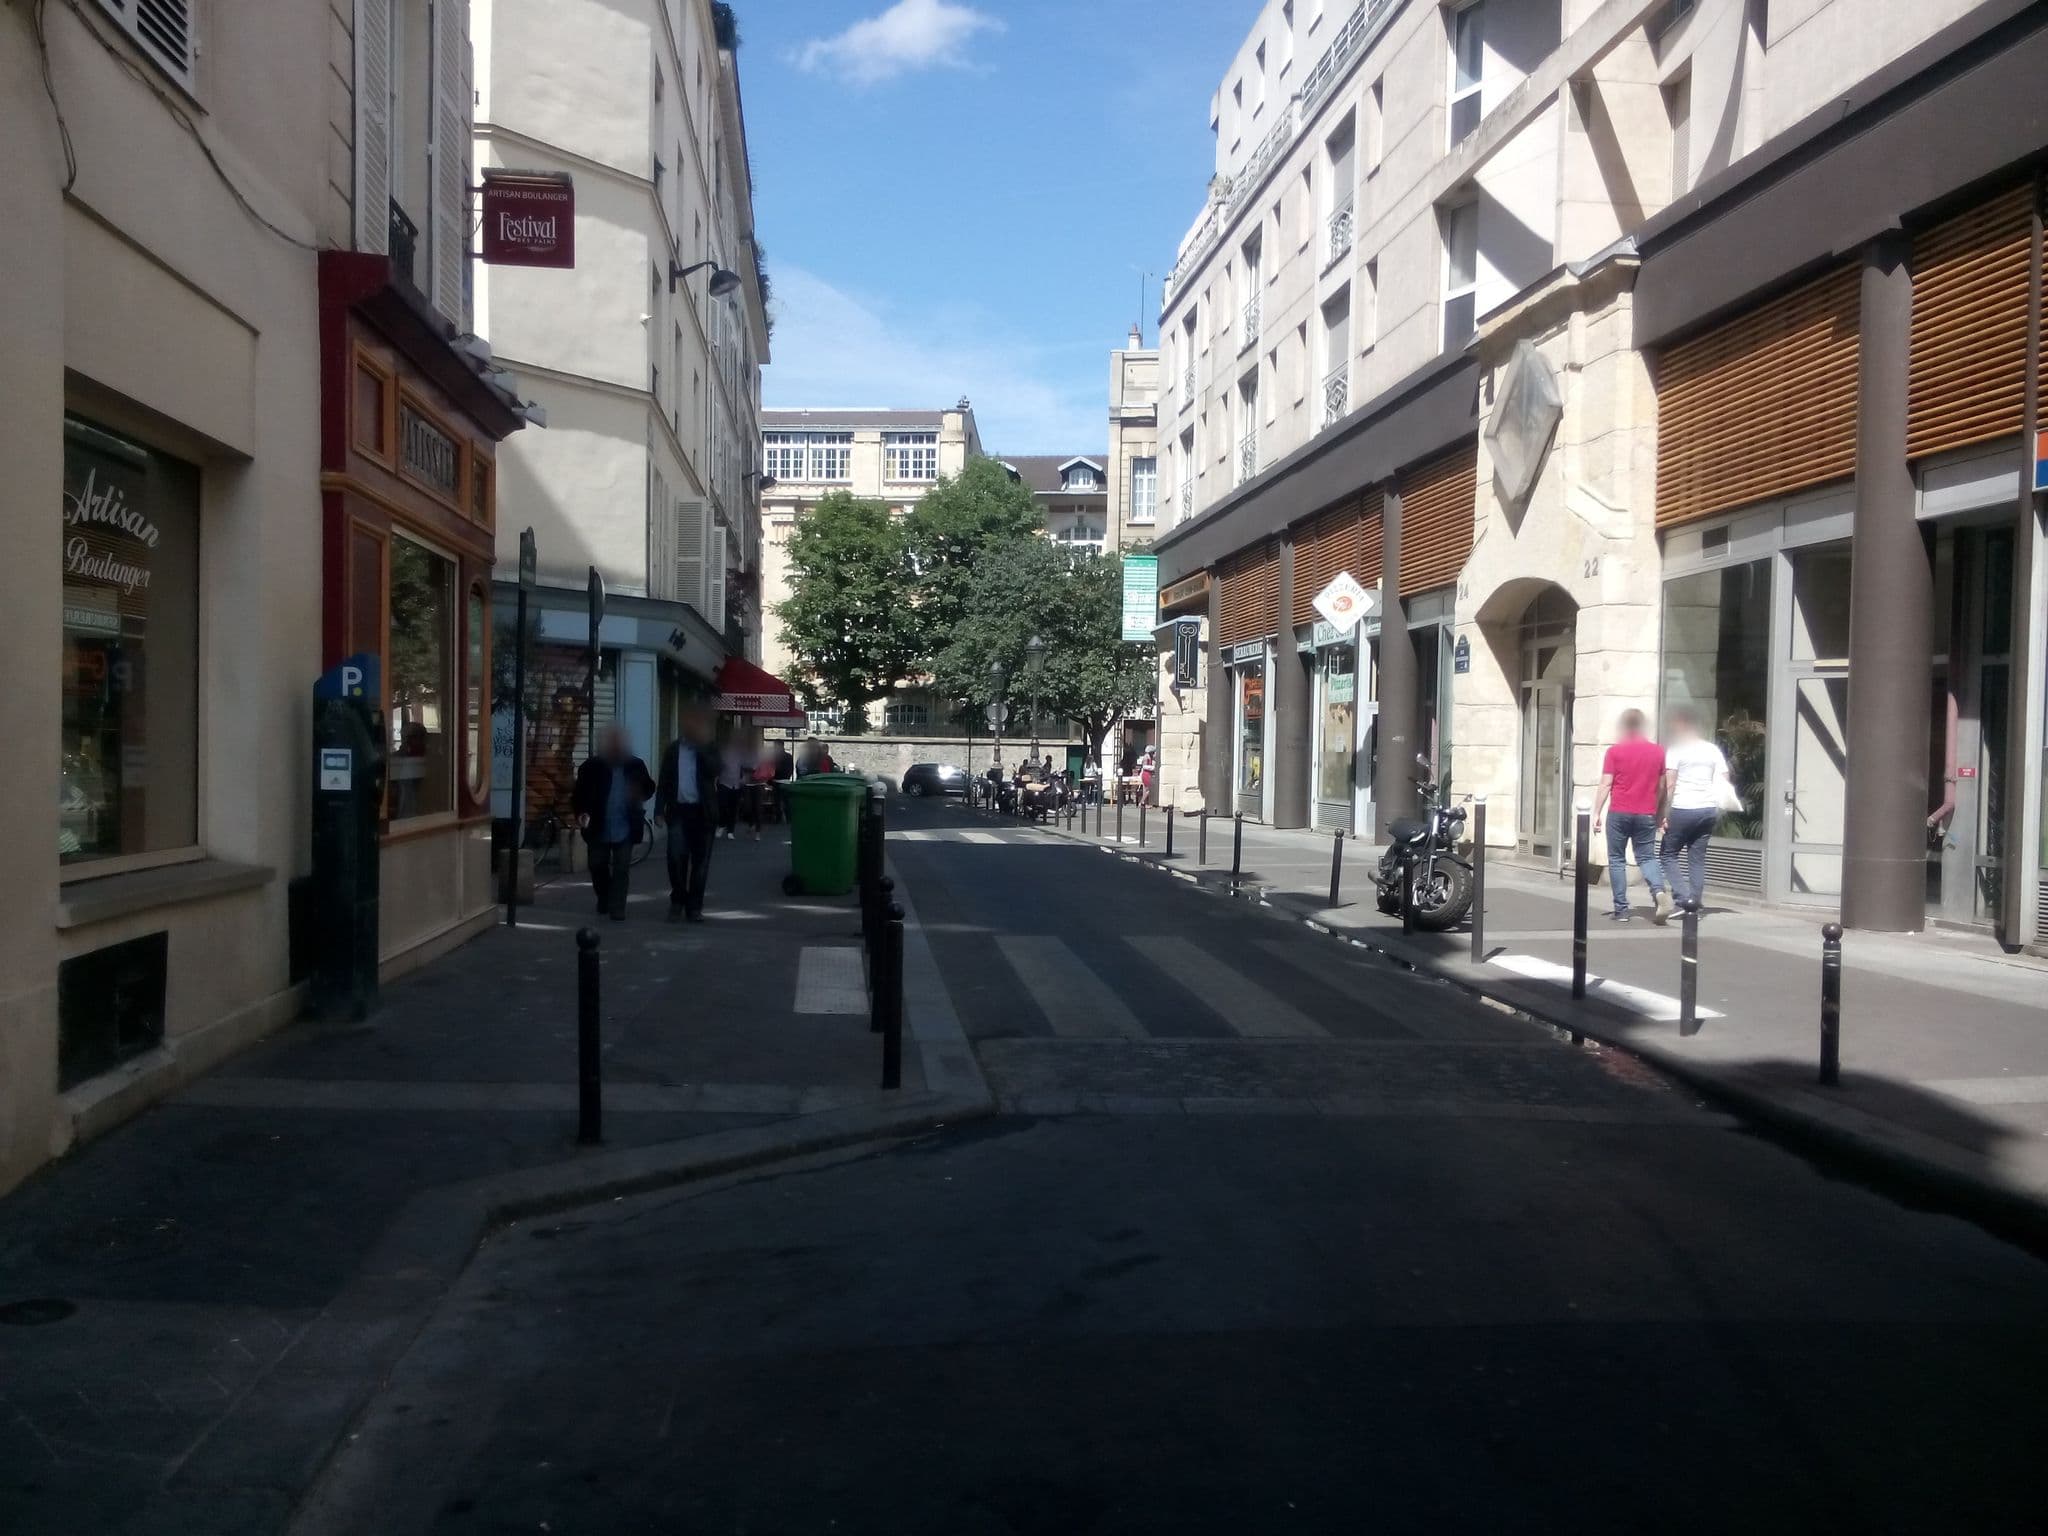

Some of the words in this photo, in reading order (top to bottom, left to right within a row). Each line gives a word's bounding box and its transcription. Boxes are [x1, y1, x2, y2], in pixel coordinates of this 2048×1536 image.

[488, 189, 520, 198] ARTISAN
[522, 191, 568, 201] BOULANGER
[499, 211, 556, 241] Festival
[64, 467, 160, 547] Artisan
[67, 536, 151, 596] Boulanger
[1584, 557, 1599, 578] 22
[1458, 583, 1469, 600] 24
[342, 666, 363, 697] P
